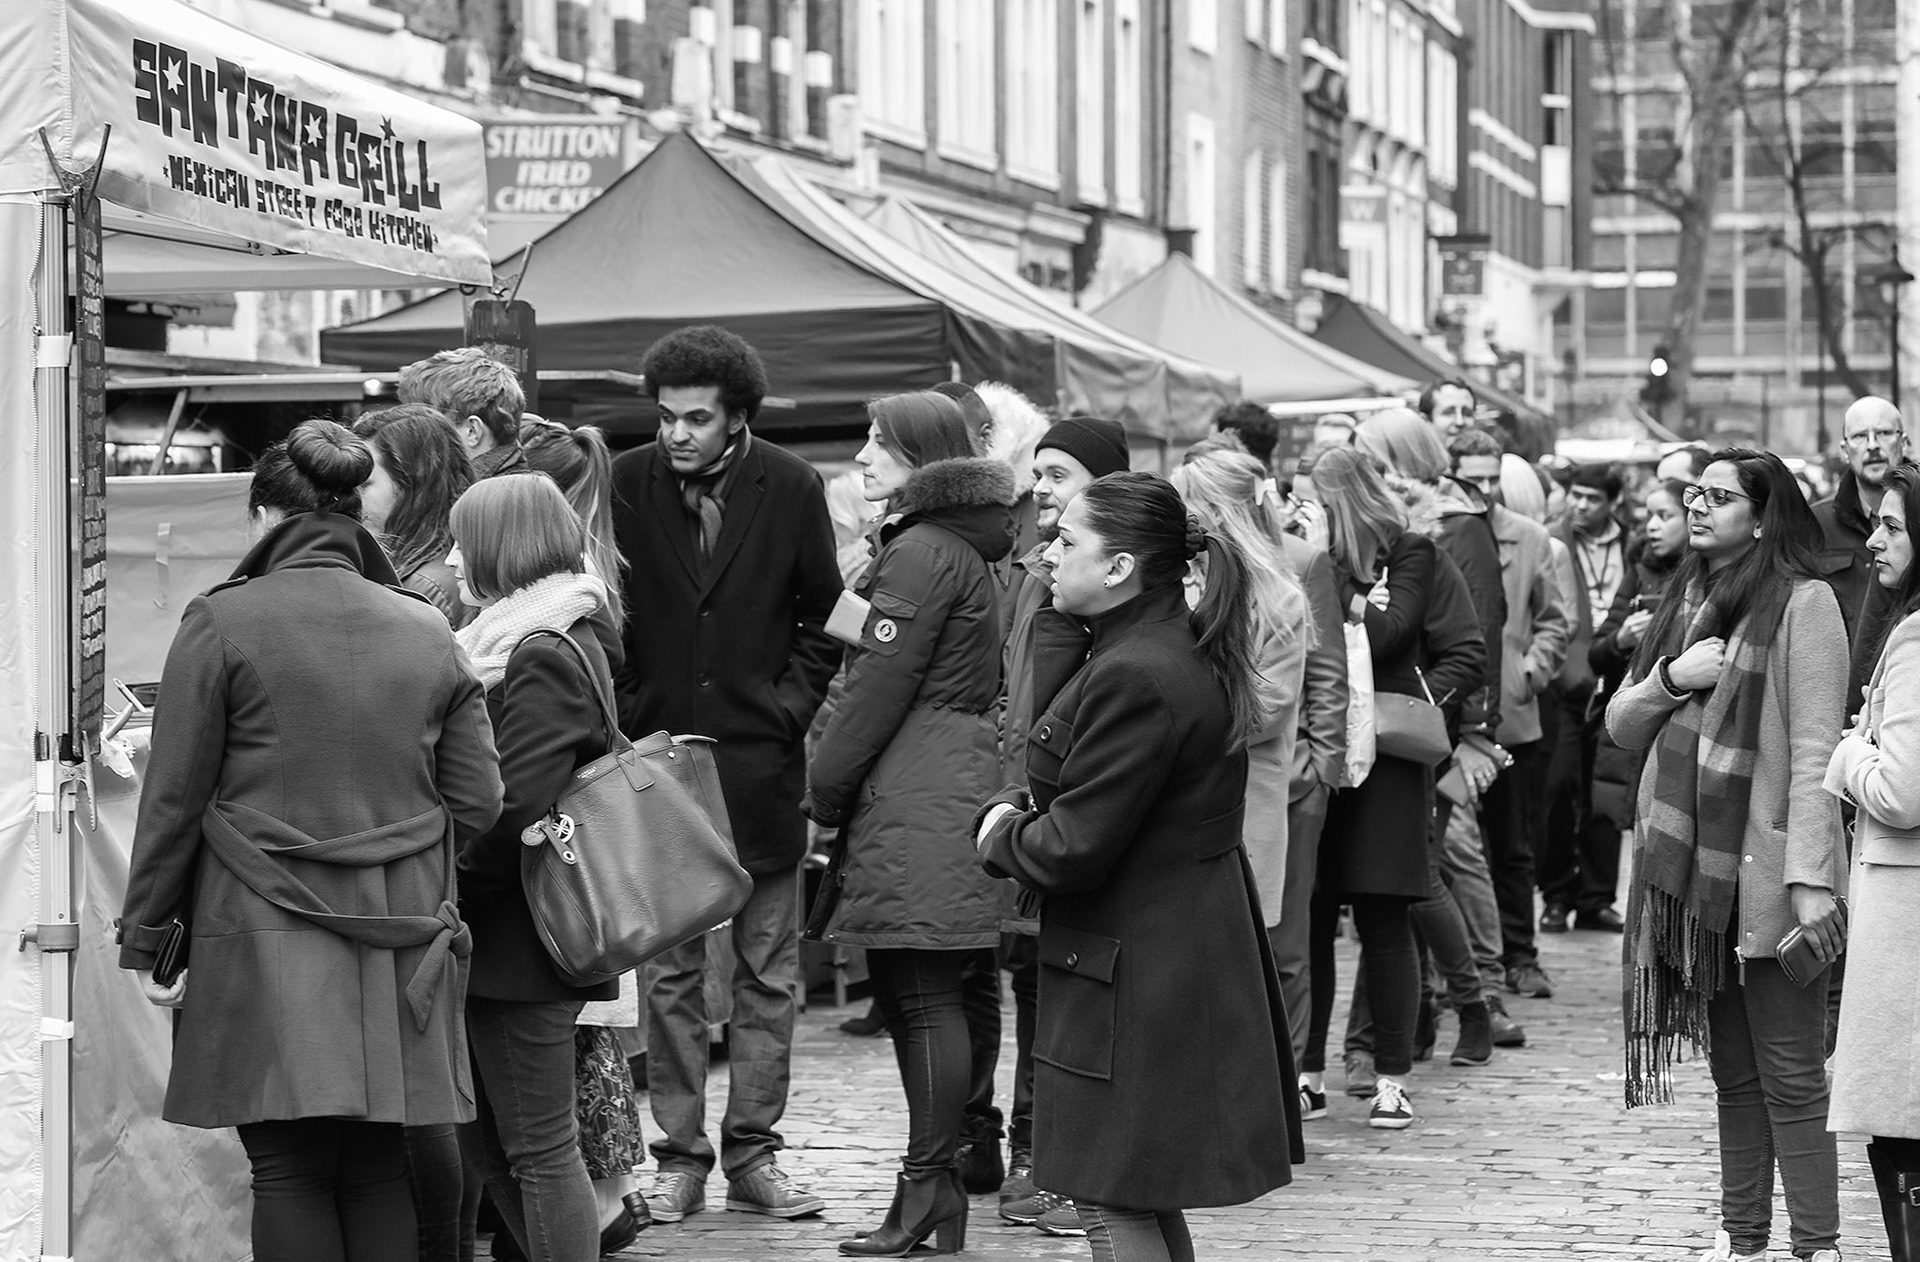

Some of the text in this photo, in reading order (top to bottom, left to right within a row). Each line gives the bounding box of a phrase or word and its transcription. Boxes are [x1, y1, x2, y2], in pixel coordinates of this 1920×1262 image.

[133, 38, 330, 187] SANTANA
[486, 125, 621, 159] STRUTTON
[517, 160, 592, 187] FRIED
[255, 179, 316, 227] STREET
[324, 198, 363, 238] FOOD
[494, 186, 604, 213] CHICKE
